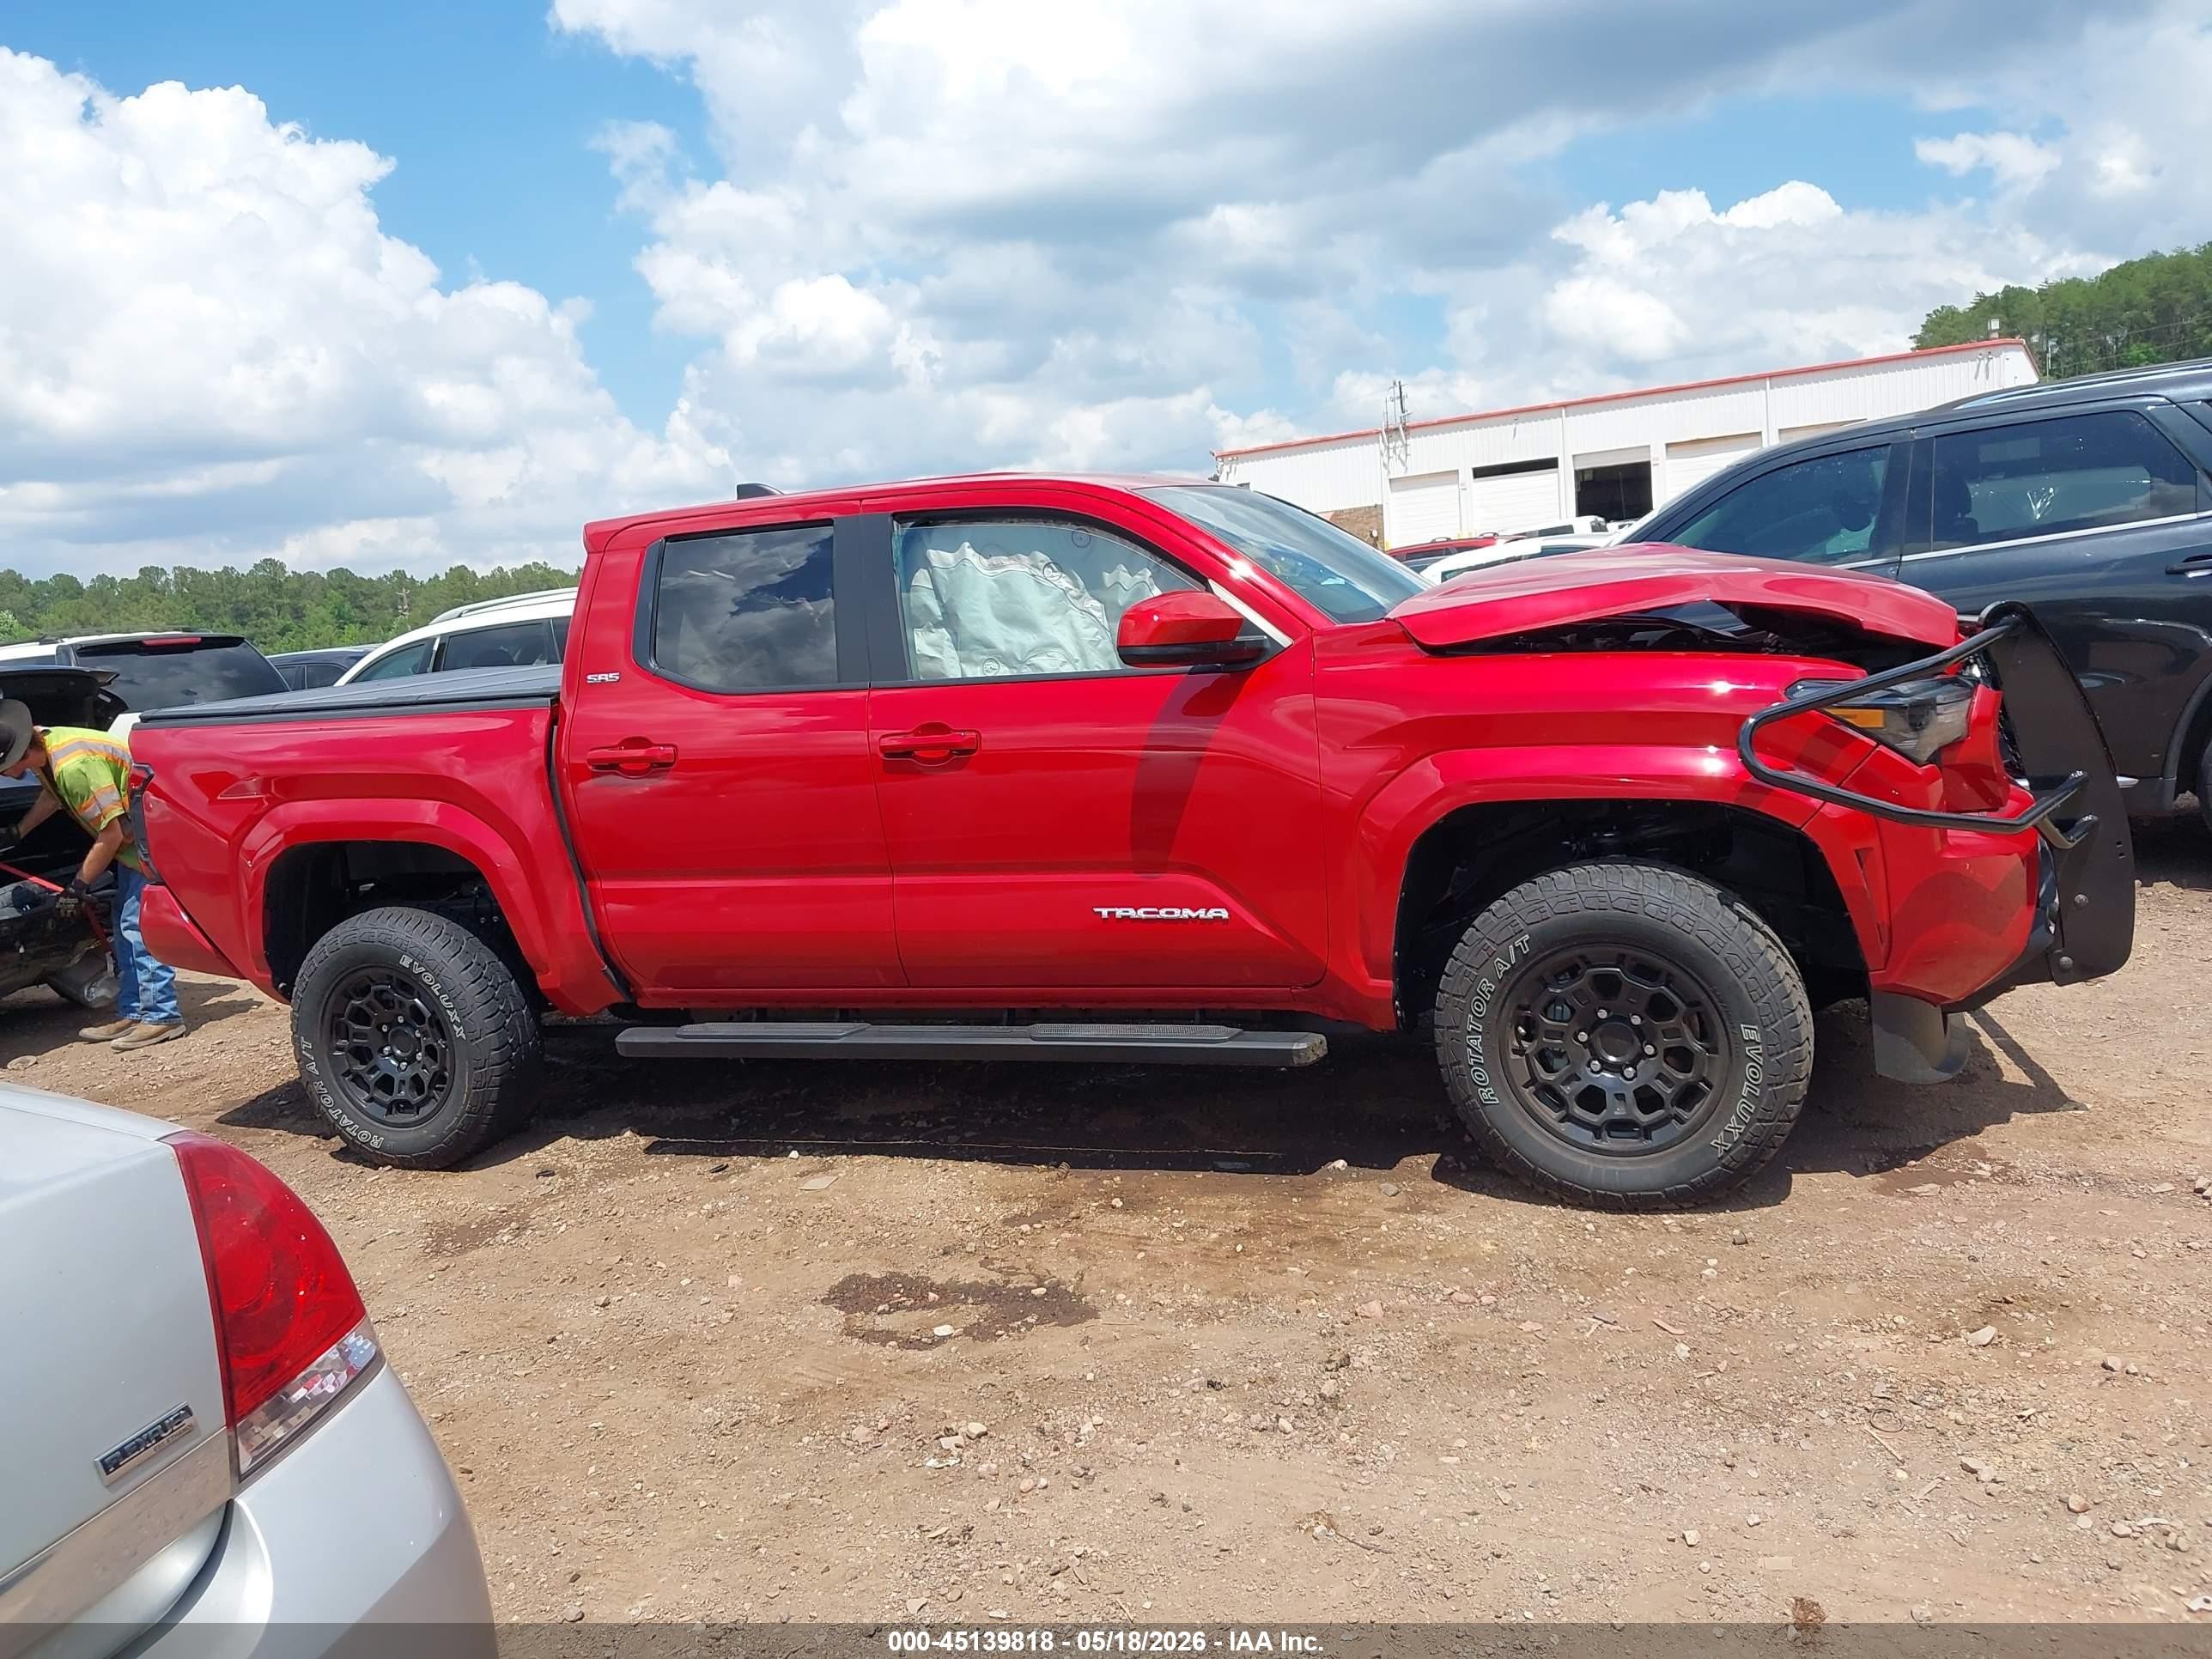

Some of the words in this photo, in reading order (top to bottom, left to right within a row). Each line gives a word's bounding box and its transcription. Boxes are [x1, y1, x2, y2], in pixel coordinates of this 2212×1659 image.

[586, 672, 620, 684] SR5
[1092, 908, 1231, 920] TACOMA
[399, 954, 466, 1040] EVOLUXX
[1466, 977, 1500, 1105] ROTATOR
[1493, 933, 1530, 980] A/T
[301, 1036, 319, 1075] A/T
[313, 1080, 385, 1149] ROTATOR
[1710, 1023, 1764, 1158] EVOLUXX
